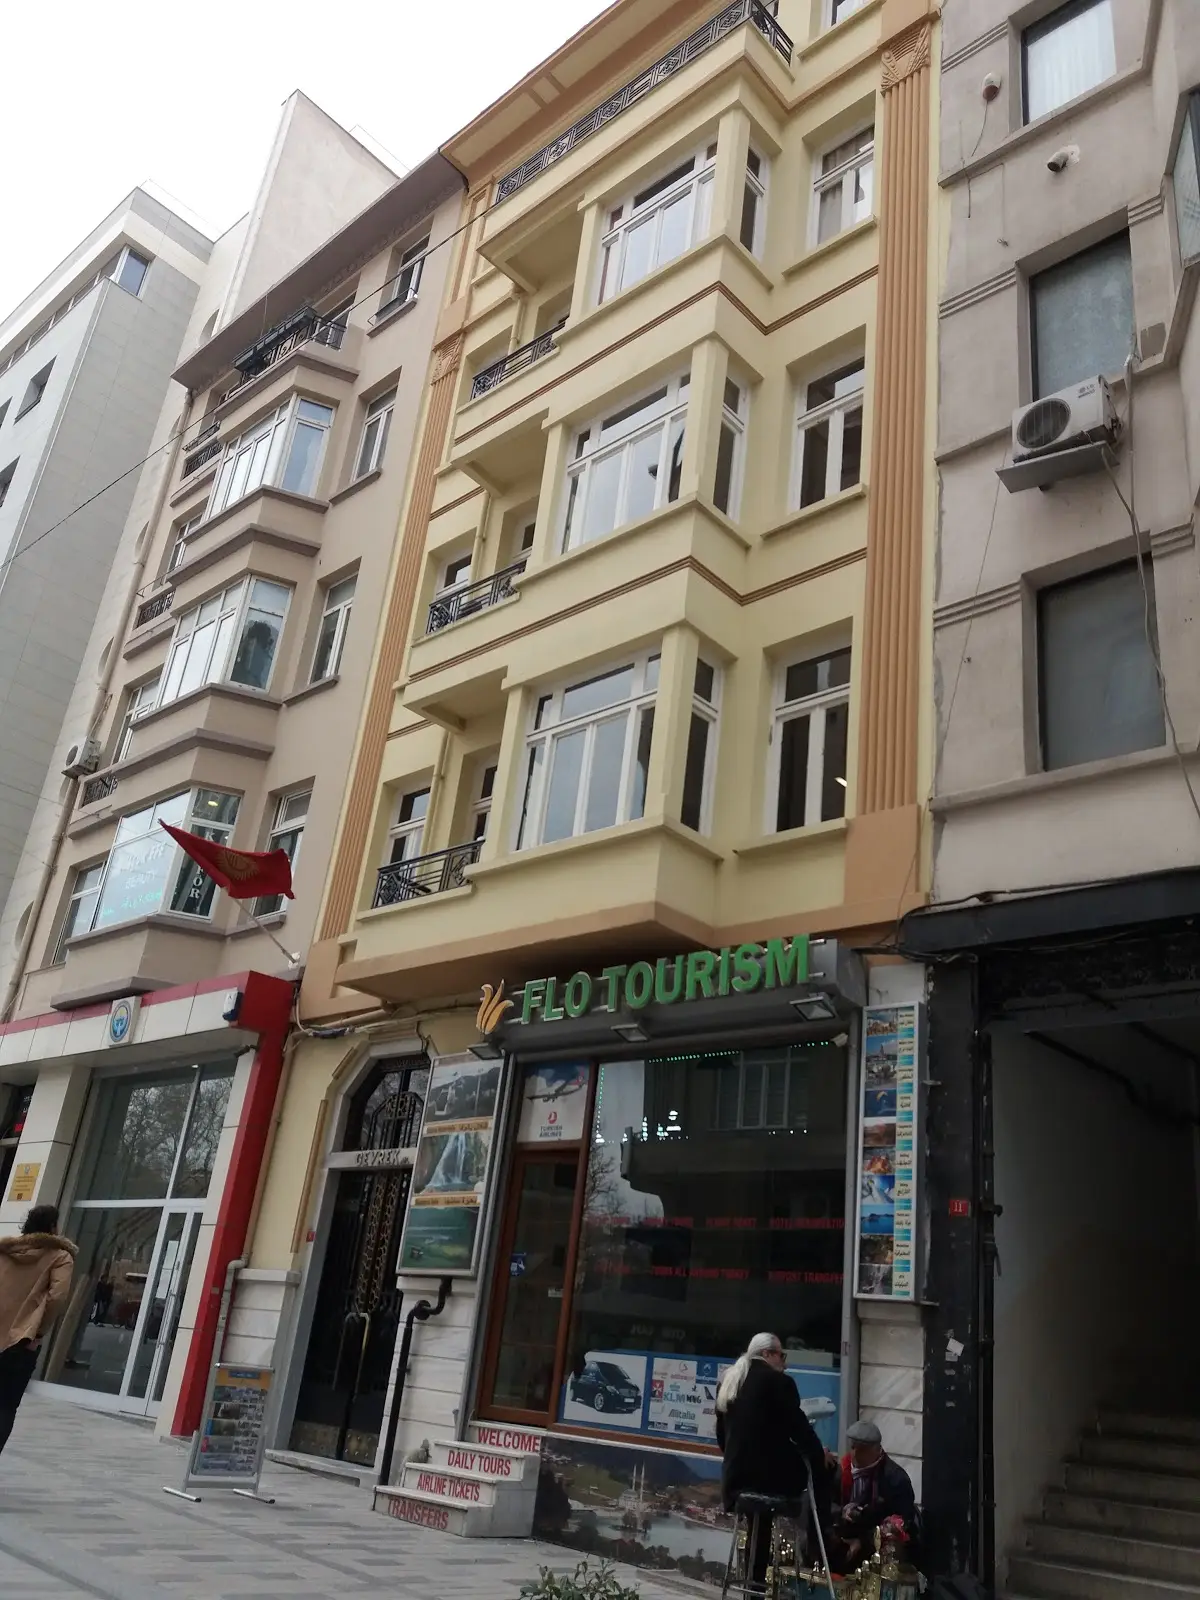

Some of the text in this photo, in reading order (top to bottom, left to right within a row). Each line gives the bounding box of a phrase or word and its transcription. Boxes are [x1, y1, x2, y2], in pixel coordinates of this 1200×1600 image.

[521, 933, 810, 1025] FLO TOURISM
[478, 1427, 541, 1453] WELCOME
[447, 1449, 511, 1477] DAILY TOURS
[417, 1473, 481, 1502] AIRLINE TICKETS
[388, 1496, 450, 1530] TRANSFERS
